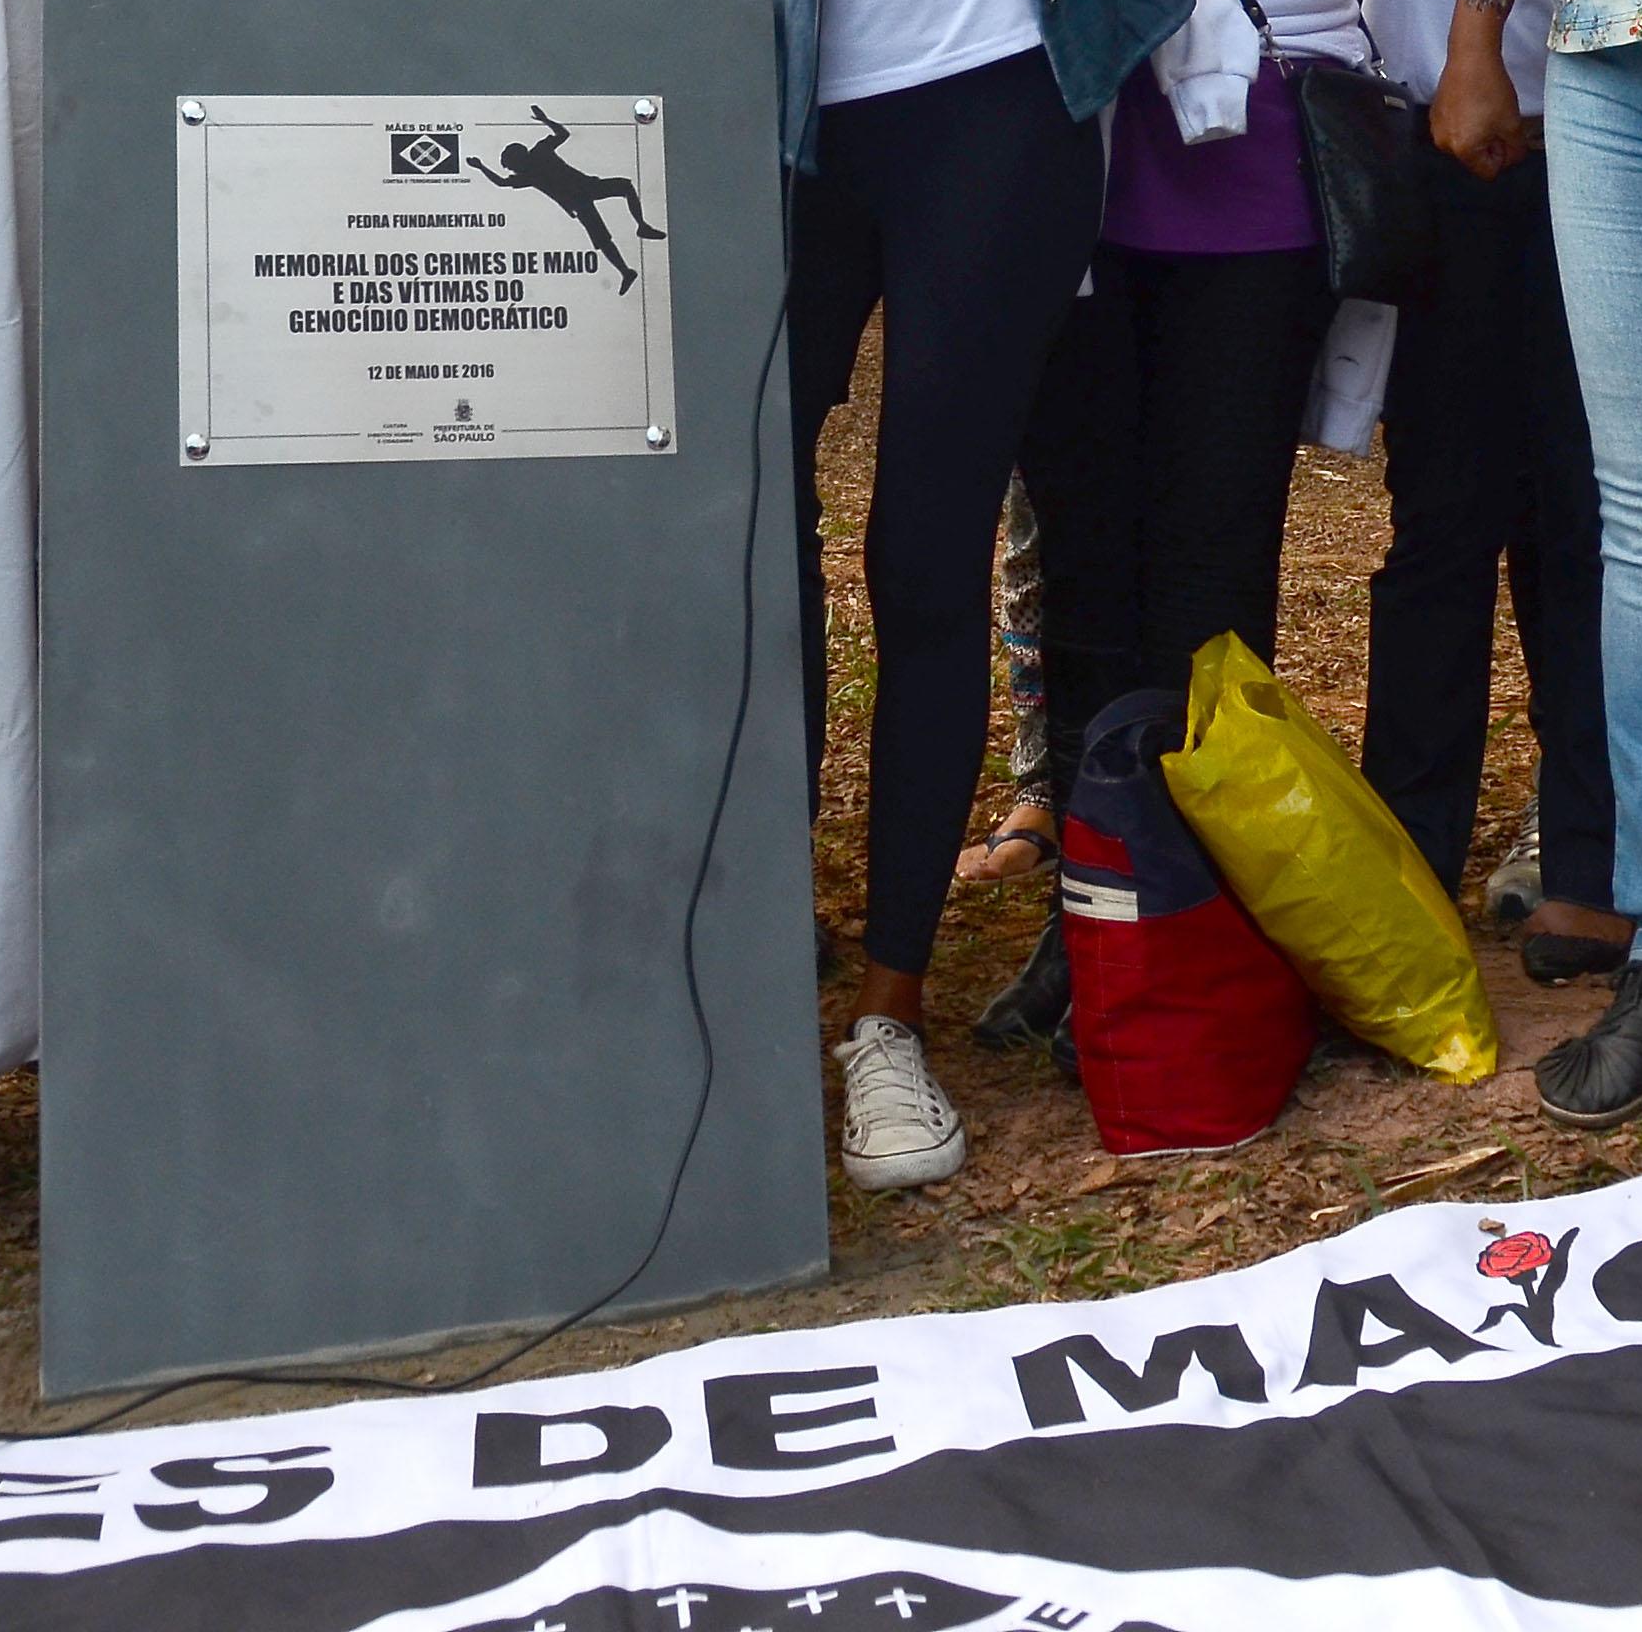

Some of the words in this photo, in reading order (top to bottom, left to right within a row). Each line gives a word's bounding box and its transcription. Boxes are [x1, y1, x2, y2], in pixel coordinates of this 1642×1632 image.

[419, 123, 433, 131] DE
[347, 215, 390, 228] PEDRA
[393, 214, 485, 228] FUNDAMENTAL
[488, 213, 506, 227] DO
[254, 254, 369, 277] MEMORIAL
[375, 253, 418, 276] DOS
[424, 252, 506, 275] CRIMES
[512, 252, 538, 274] DE
[544, 251, 599, 274] MAIO
[333, 281, 344, 304] E
[350, 280, 393, 304] DAS
[398, 277, 489, 303] VÍTIMAS
[495, 279, 524, 302] DO
[289, 306, 408, 333] GENOCÍDIO
[414, 304, 568, 331] DEMOCRÁTICO
[368, 366, 382, 380] 12
[386, 366, 401, 380] DE
[405, 365, 439, 379] MAIO
[443, 365, 459, 378] DE
[462, 364, 494, 378] 2016
[458, 432, 495, 442] PAULO
[472, 1364, 895, 1489] DE
